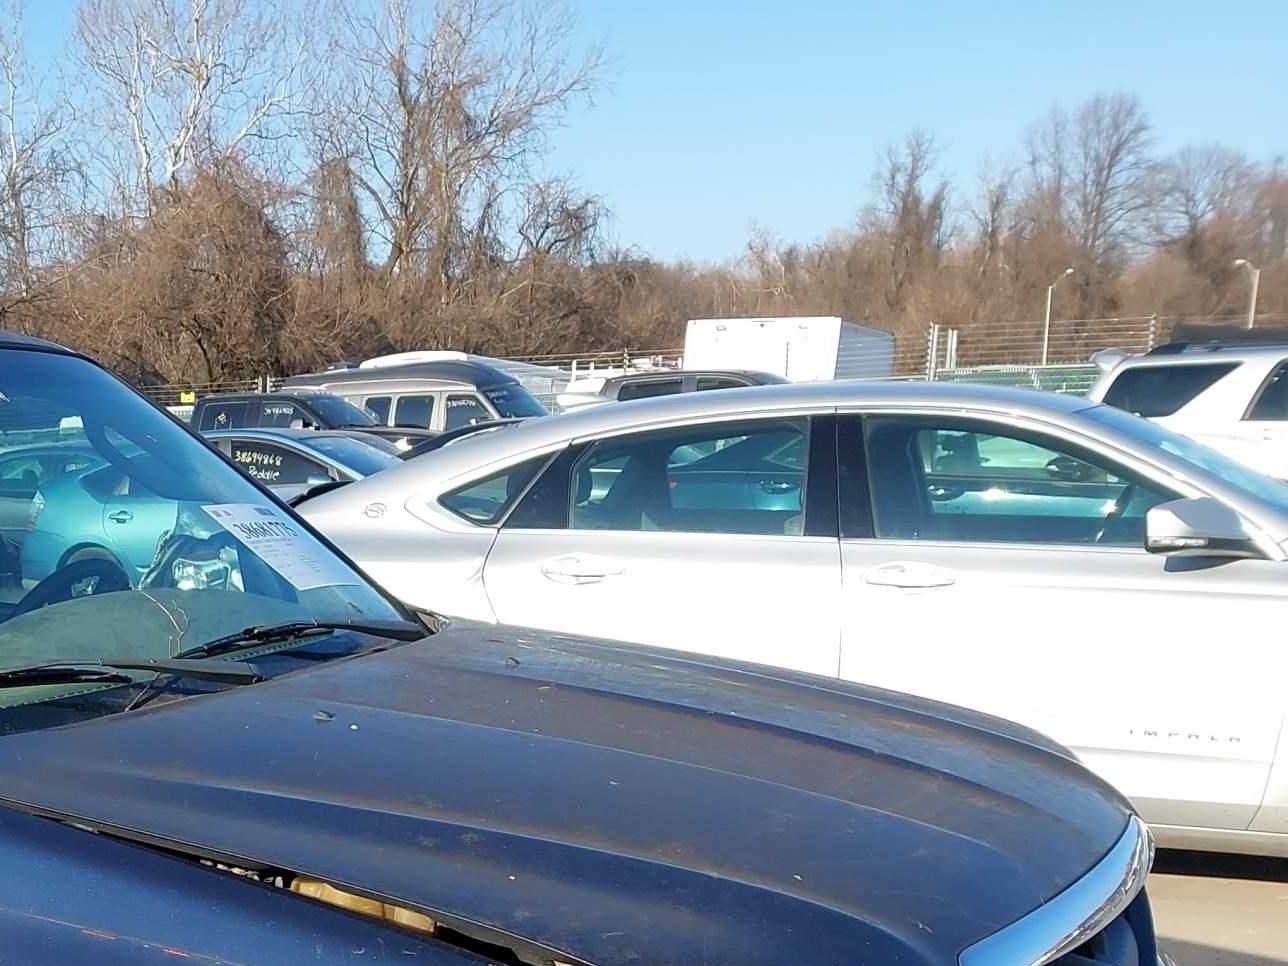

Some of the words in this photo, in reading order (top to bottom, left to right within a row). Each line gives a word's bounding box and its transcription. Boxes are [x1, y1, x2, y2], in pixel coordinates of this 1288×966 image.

[234, 450, 283, 466] 38694868
[233, 521, 298, 539] 38681775
[1129, 729, 1241, 743] IMPALA
